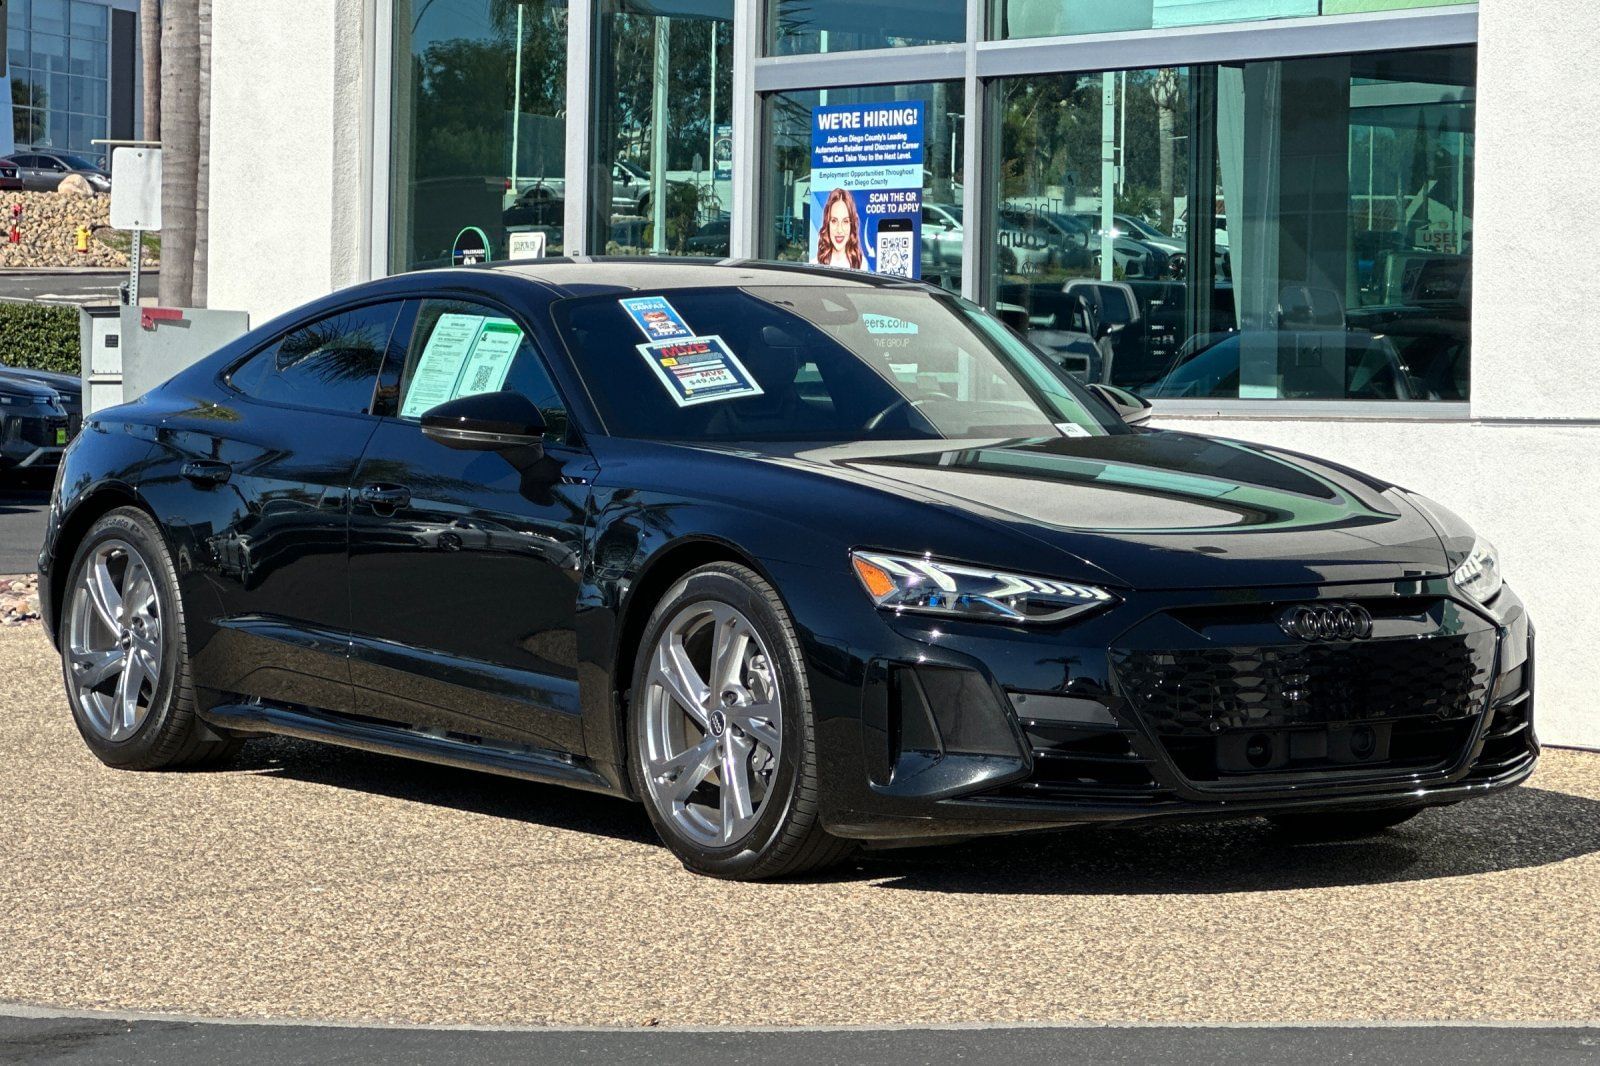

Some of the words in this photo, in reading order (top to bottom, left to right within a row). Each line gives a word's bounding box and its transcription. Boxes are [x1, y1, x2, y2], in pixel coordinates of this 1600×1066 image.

[818, 113, 860, 130] WE'RE
[864, 109, 918, 127] HIRING!
[850, 170, 884, 178] Opportunities
[885, 168, 914, 177] Throughout
[870, 193, 888, 203] SCAN
[890, 192, 904, 202] THE
[906, 192, 916, 201] QR
[866, 204, 886, 214] CODE
[887, 203, 896, 213] TO
[898, 203, 919, 213] APPLY
[700, 369, 725, 378] MVP
